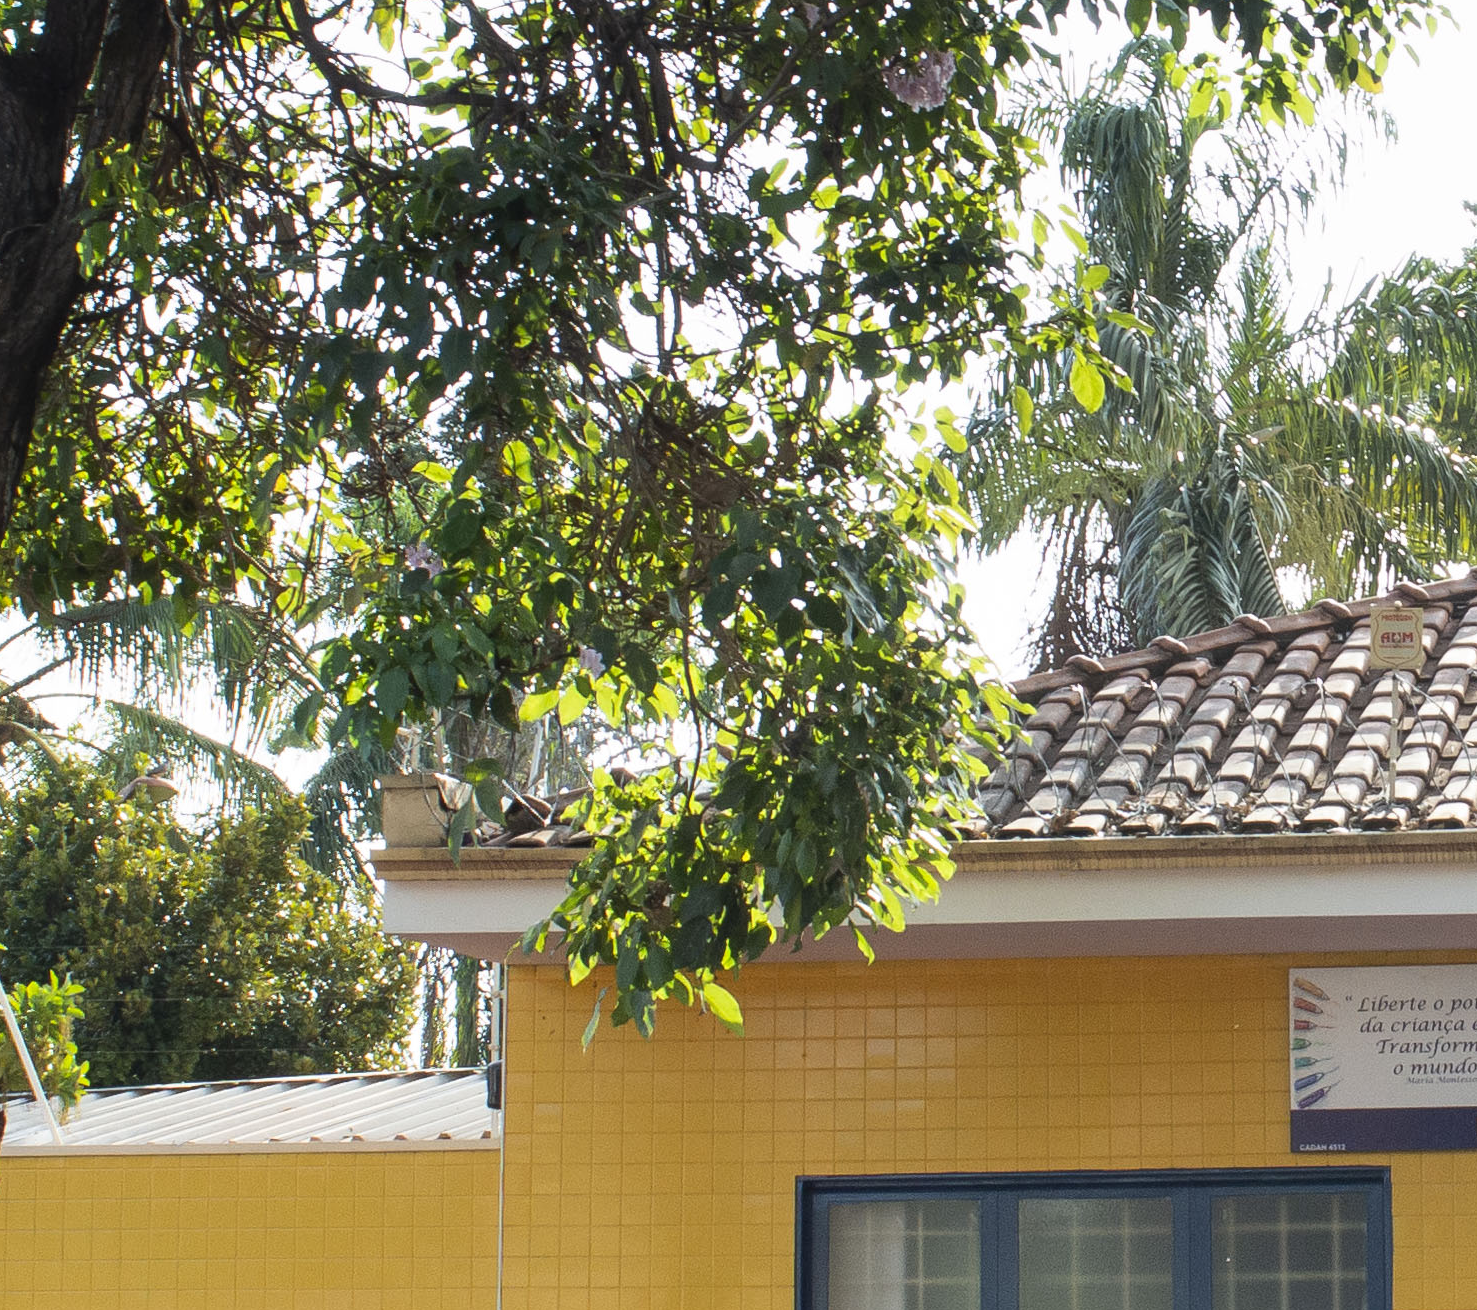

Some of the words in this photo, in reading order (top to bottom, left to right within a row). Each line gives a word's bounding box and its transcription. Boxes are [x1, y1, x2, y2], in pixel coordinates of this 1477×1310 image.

[1433, 998, 1444, 1010] o
[1359, 1016, 1384, 1033] da
[1390, 1017, 1465, 1035] criança
[1393, 1064, 1404, 1076] o
